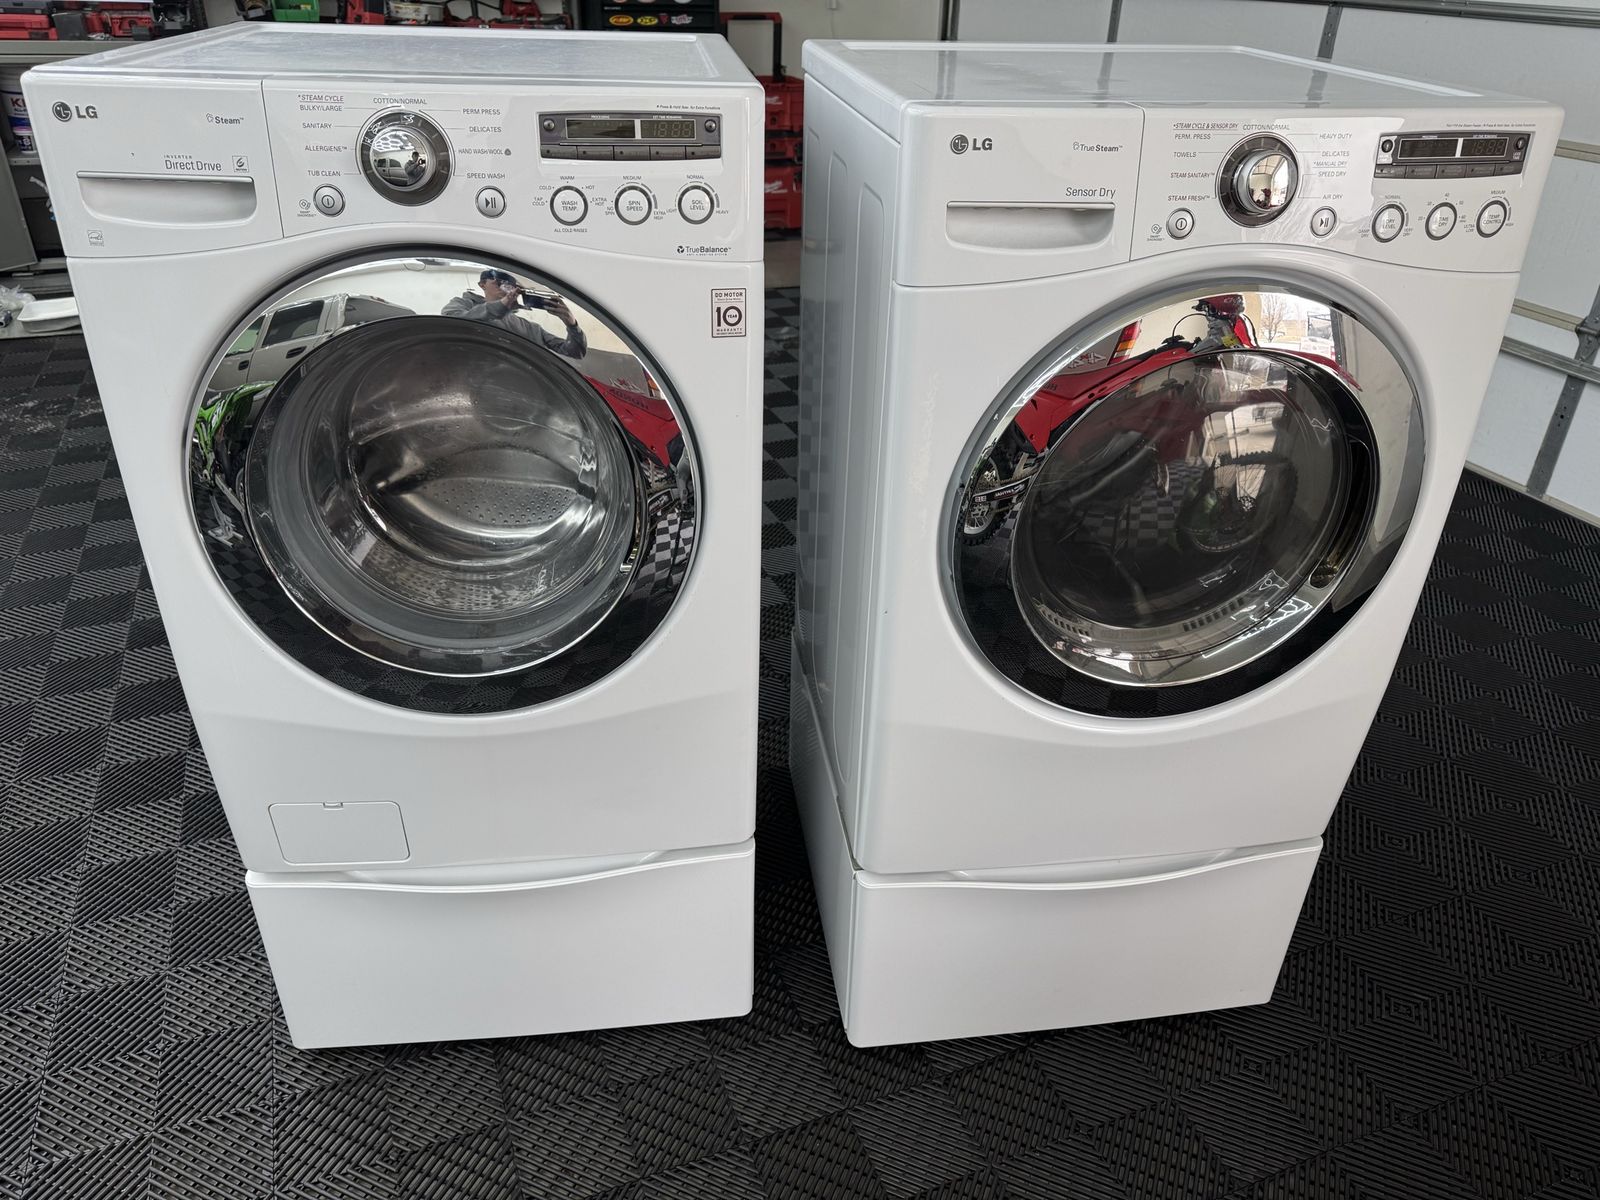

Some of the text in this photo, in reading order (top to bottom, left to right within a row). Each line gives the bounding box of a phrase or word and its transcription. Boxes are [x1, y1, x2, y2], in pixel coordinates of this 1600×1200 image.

[75, 105, 98, 119] LG
[972, 138, 993, 151] LG
[165, 160, 222, 171] Direct Drive
[1065, 187, 1116, 200] Sensor Dry
[716, 306, 743, 327] 10
